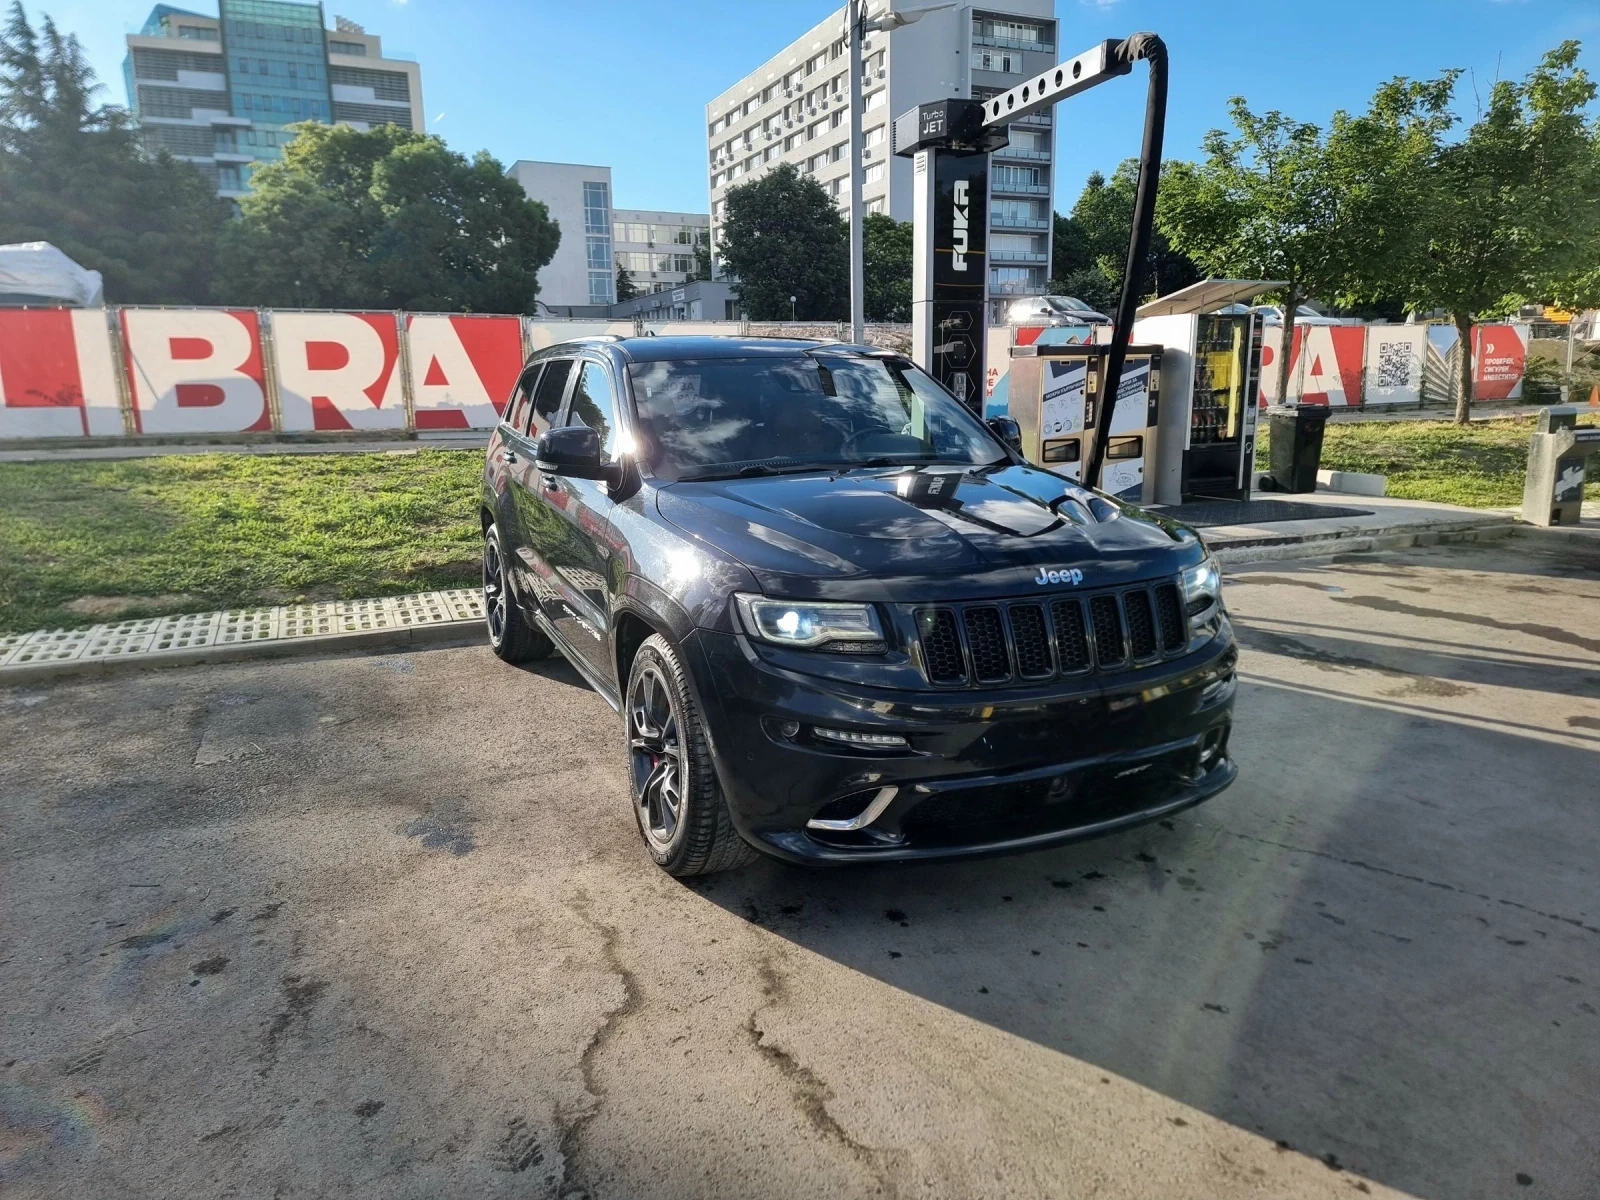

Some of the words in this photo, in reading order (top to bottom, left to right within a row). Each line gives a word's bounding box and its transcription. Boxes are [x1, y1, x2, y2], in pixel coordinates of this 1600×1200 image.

[923, 110, 944, 121] Turbo
[923, 120, 943, 134] JET
[953, 180, 969, 271] FUKA
[0, 308, 505, 436] IBRA
[1035, 567, 1083, 585] Jeep
